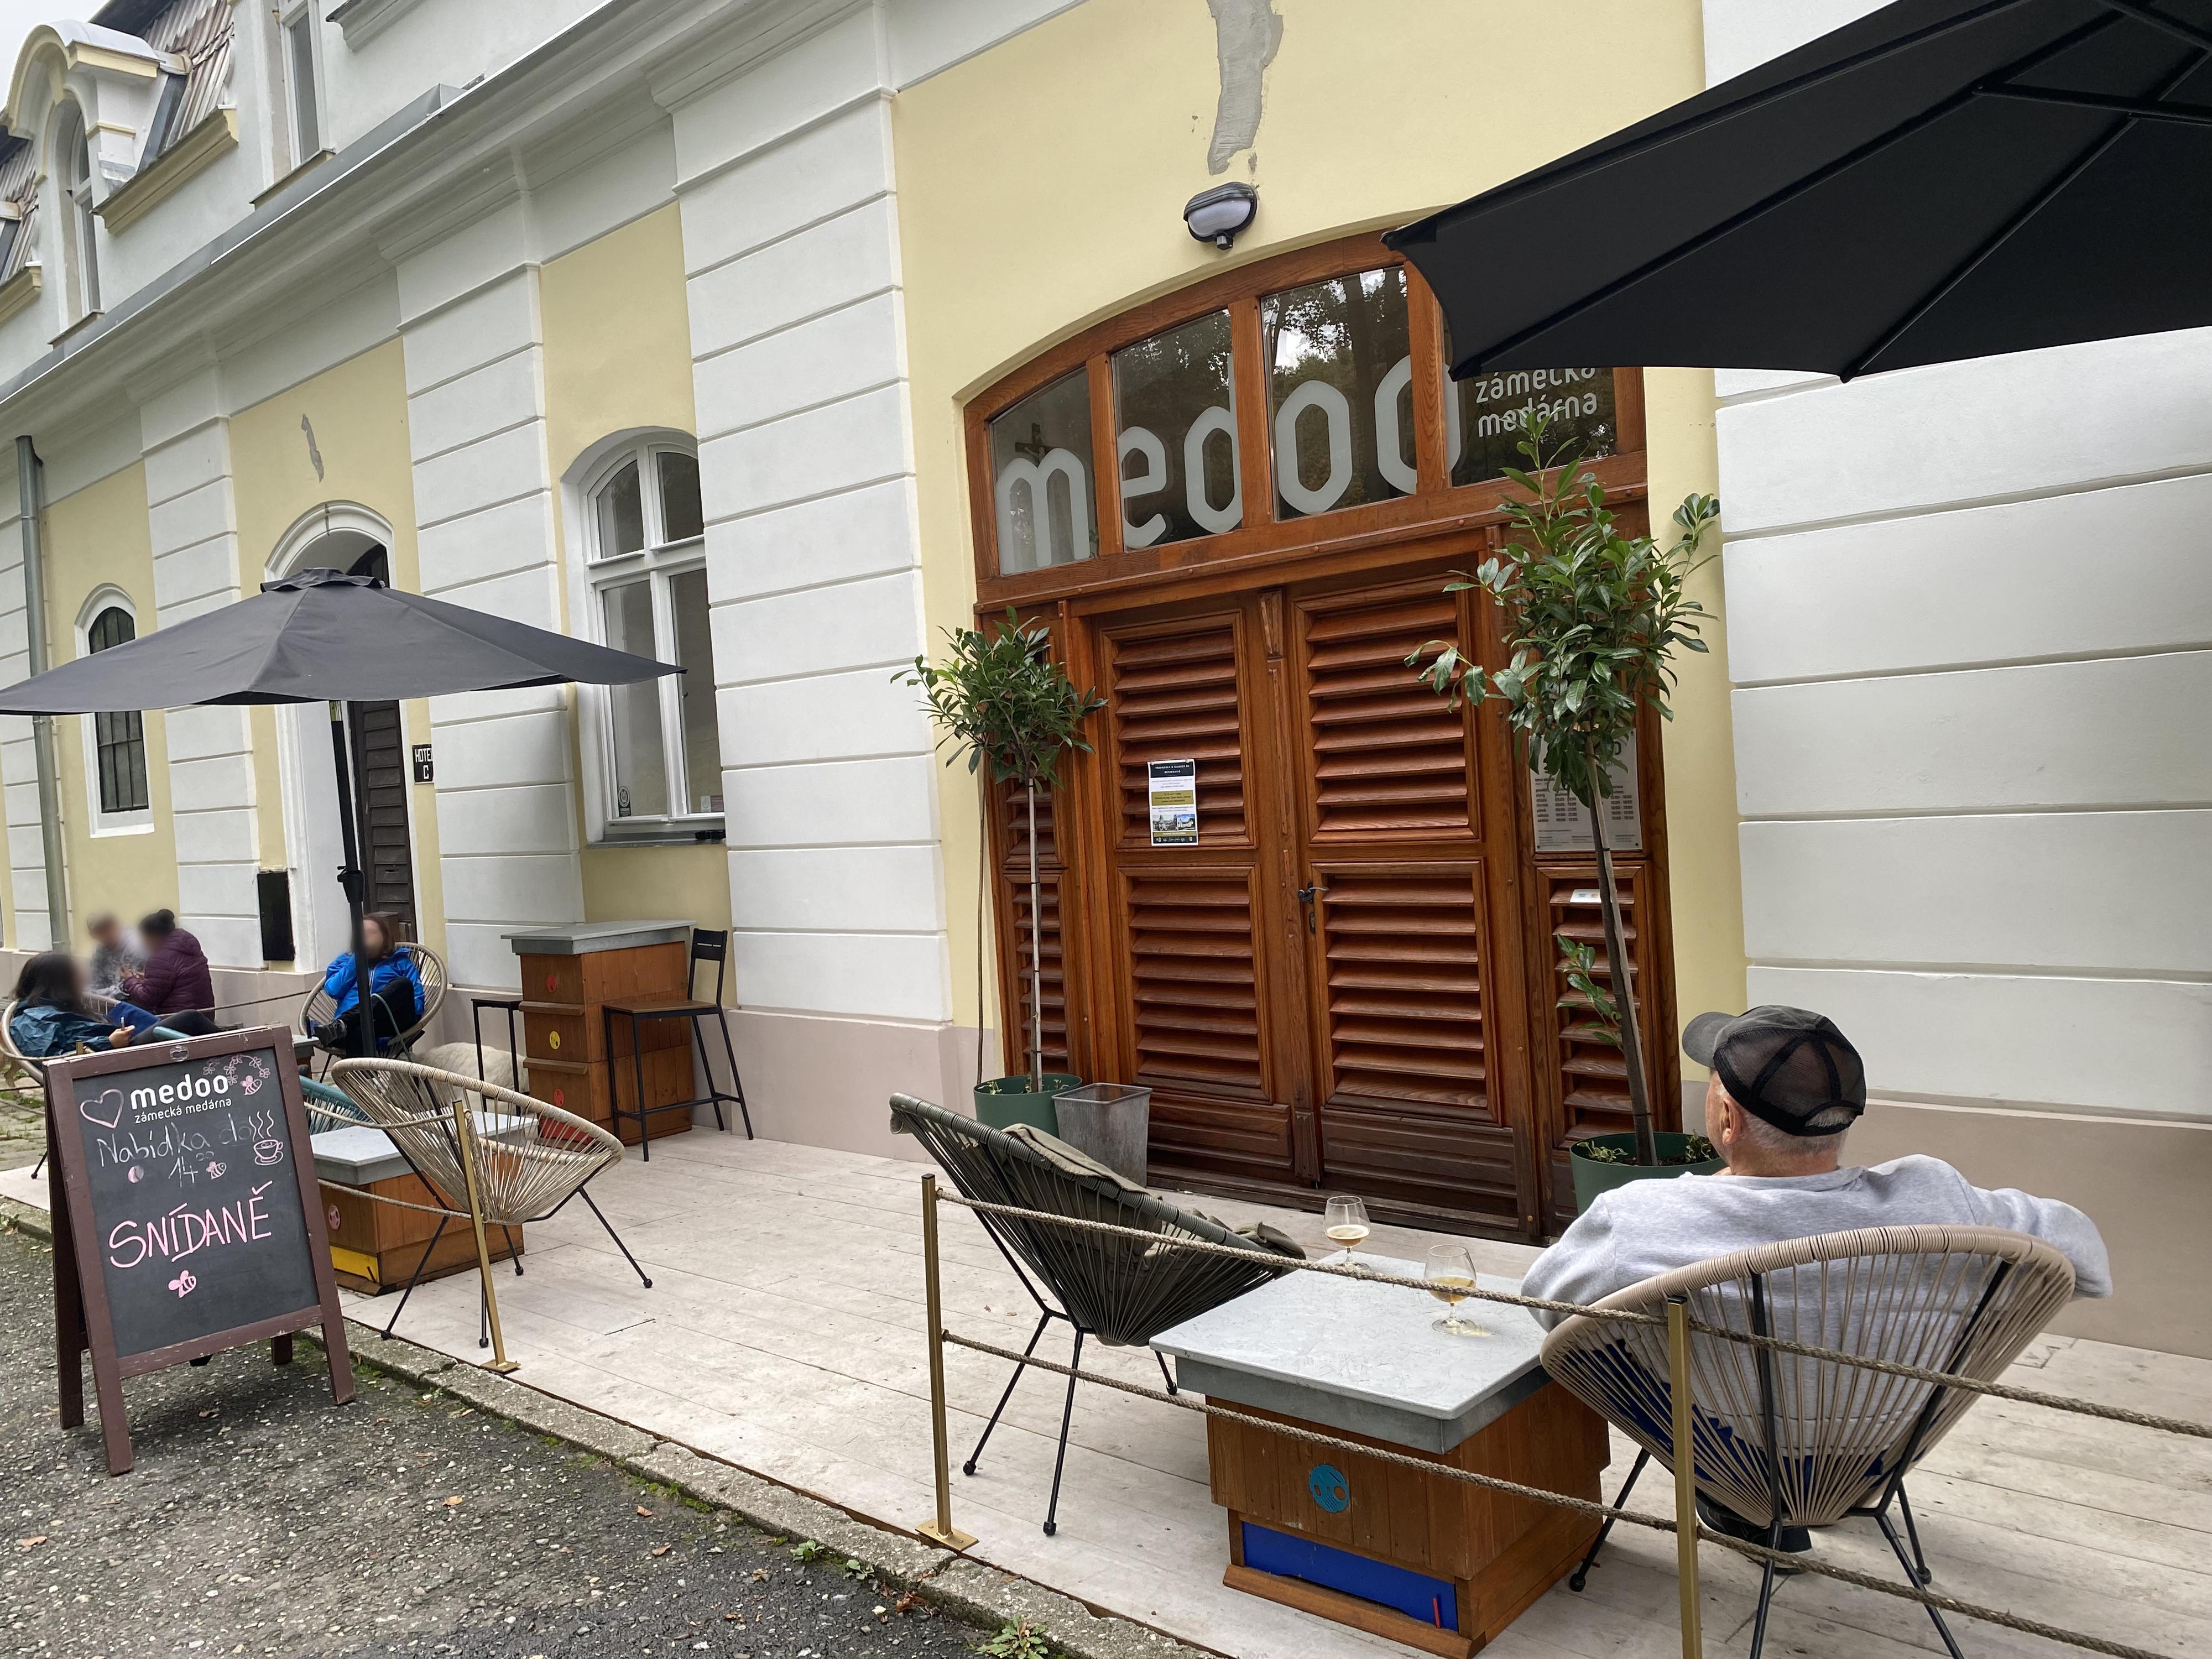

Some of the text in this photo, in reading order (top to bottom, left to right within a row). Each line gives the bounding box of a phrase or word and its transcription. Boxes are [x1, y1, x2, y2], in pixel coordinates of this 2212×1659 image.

[995, 354, 1460, 575] medoo
[414, 747, 432, 763] HOTE
[423, 765, 429, 779] C
[130, 1073, 229, 1110] medoo
[134, 1098, 232, 1124] zámecká medárna
[96, 1121, 211, 1167] Nabídka
[109, 1180, 273, 1268] SNÍDANĚ
